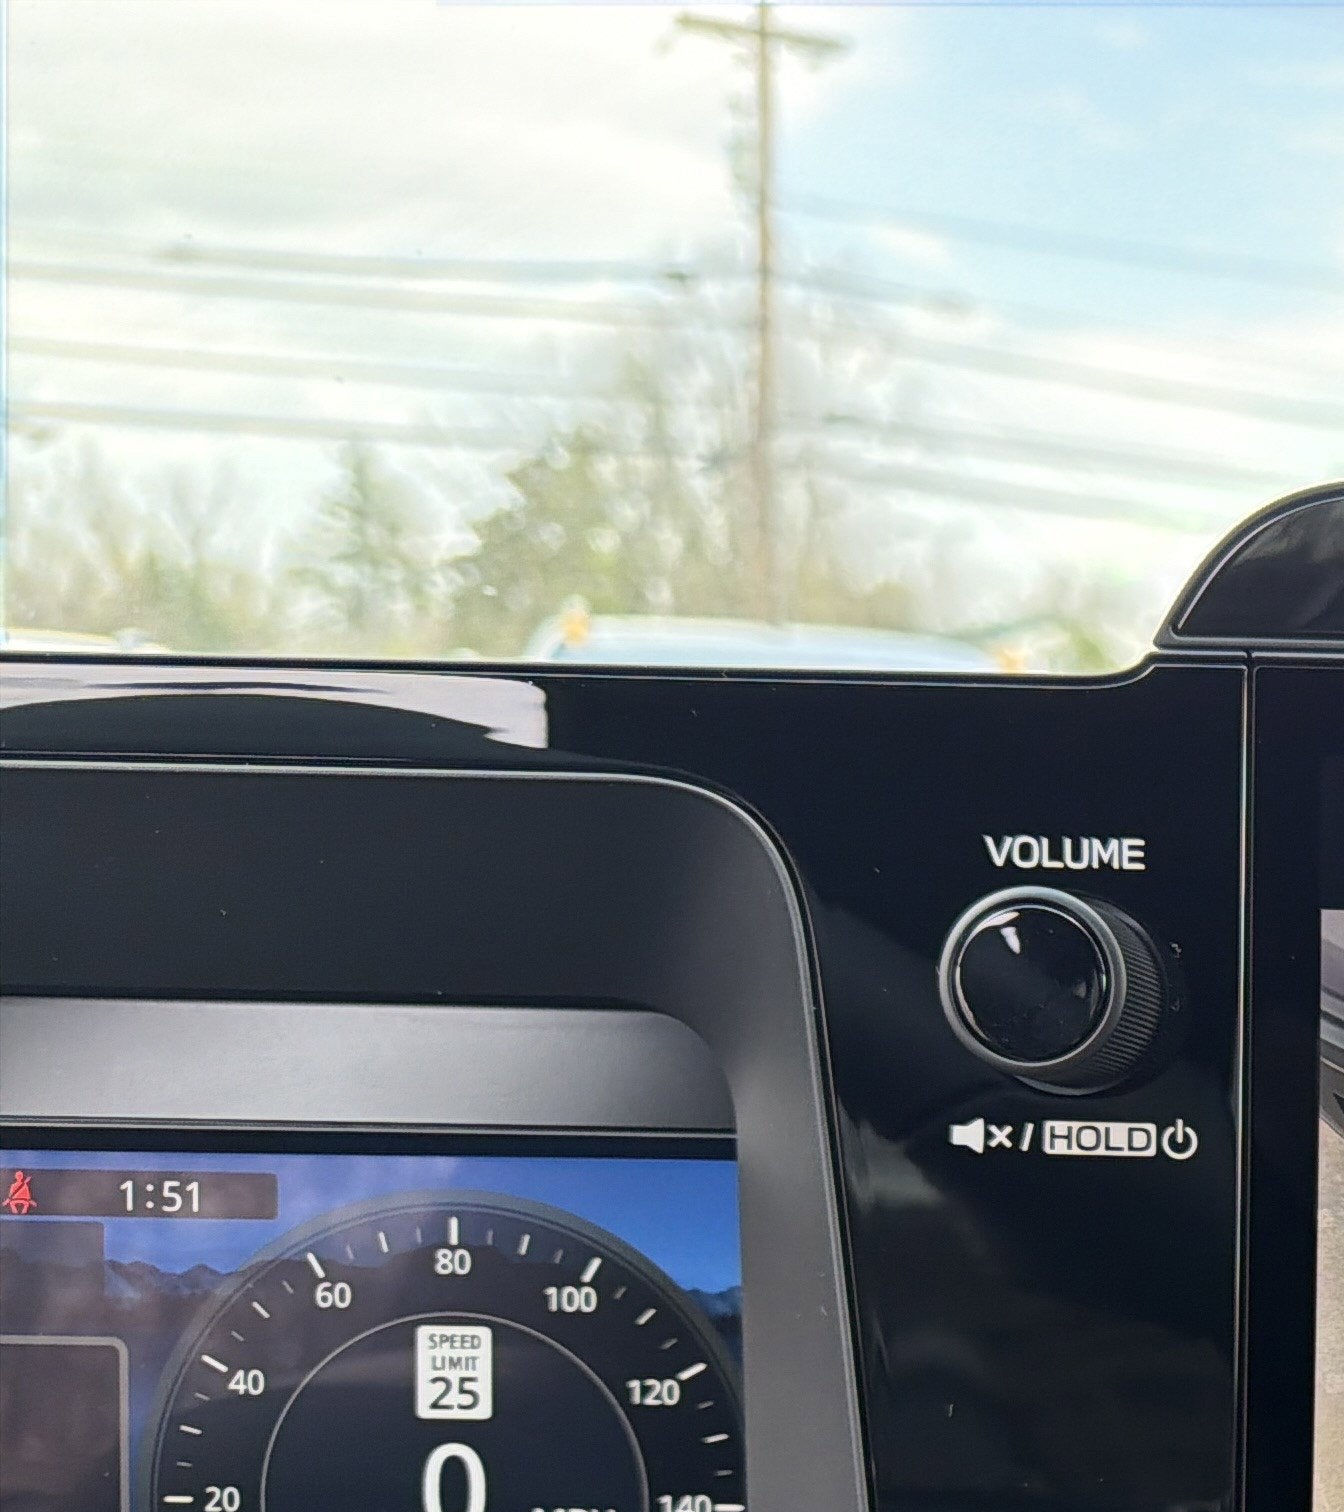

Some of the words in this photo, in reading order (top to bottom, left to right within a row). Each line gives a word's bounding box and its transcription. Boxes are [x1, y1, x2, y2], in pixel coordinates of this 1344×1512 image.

[983, 834, 1146, 871] VOLUME
[1048, 1125, 1152, 1151] HOLD
[119, 1180, 202, 1213] 1:51
[434, 1250, 472, 1275] 80
[315, 1284, 352, 1309] 60
[545, 1287, 597, 1313] 100
[427, 1334, 482, 1350] SPEED
[431, 1355, 480, 1372] LIMIT
[228, 1370, 265, 1396] 40
[429, 1378, 481, 1410] 25
[627, 1379, 679, 1406] 120
[204, 1487, 240, 1512] 20
